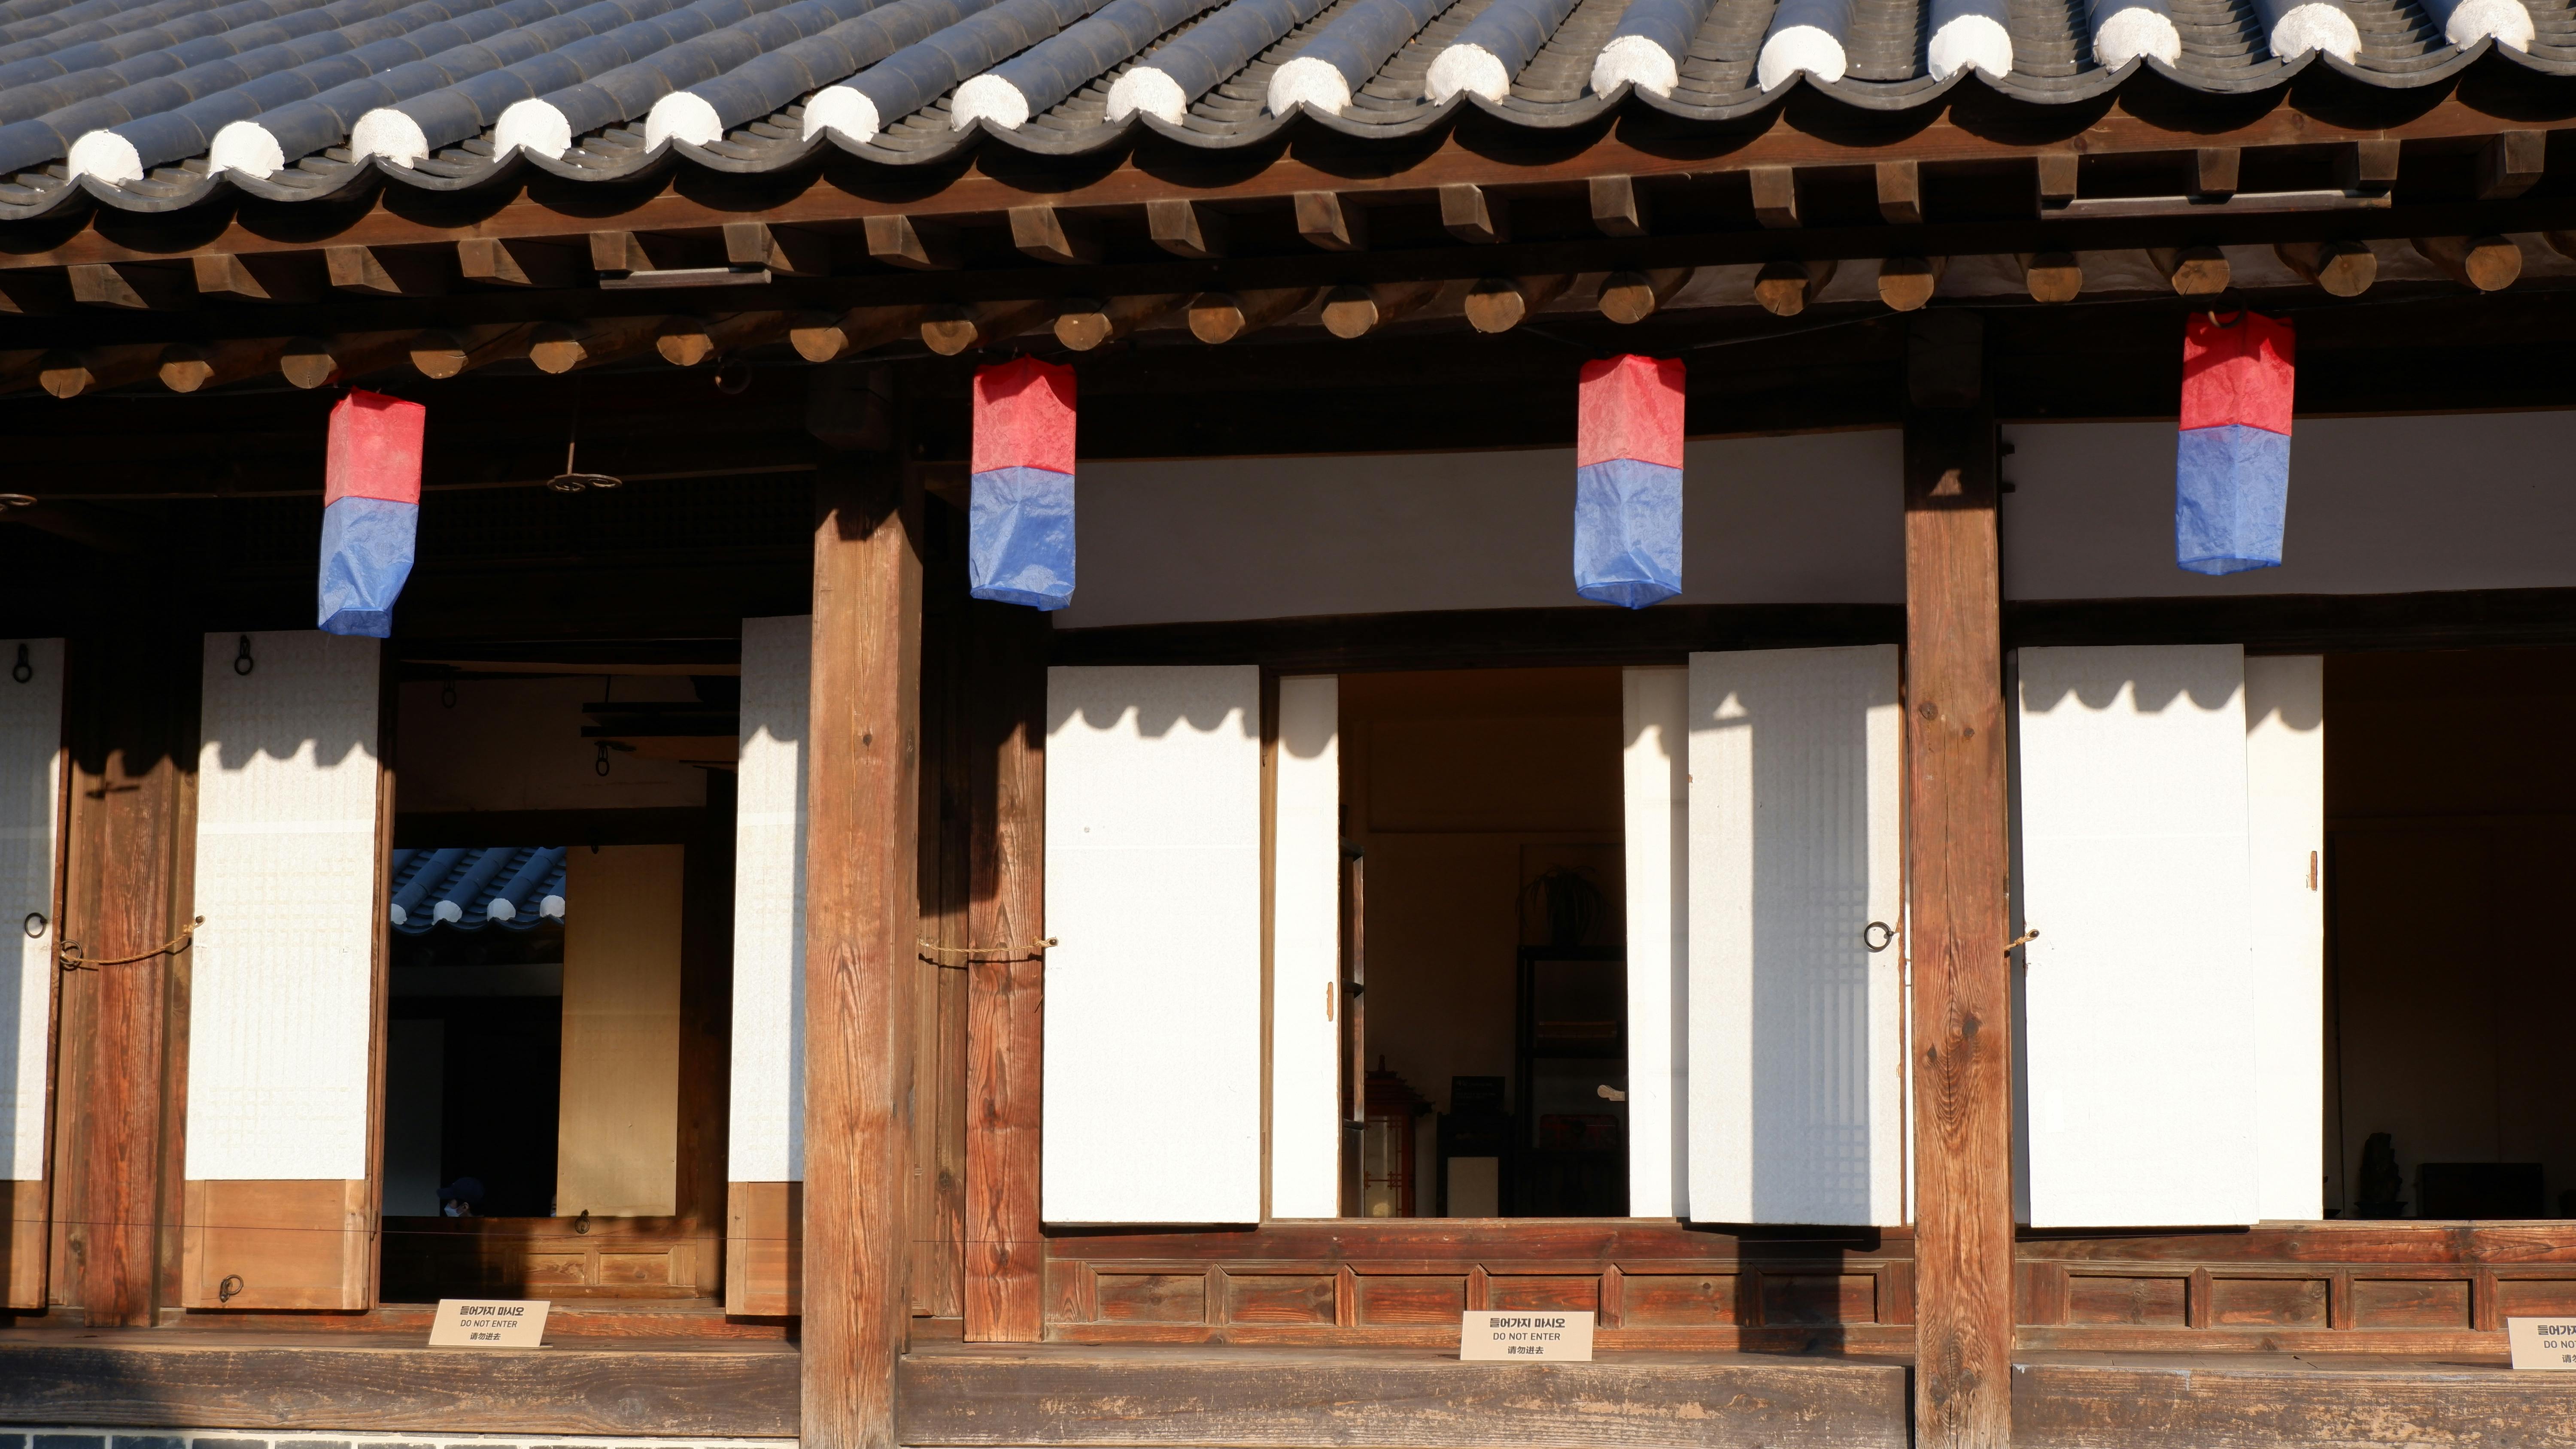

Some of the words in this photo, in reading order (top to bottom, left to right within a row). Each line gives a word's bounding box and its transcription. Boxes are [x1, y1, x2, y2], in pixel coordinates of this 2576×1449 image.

[460, 1306, 496, 1315] 들어가지
[498, 1307, 524, 1316] 마시오
[1490, 1318, 1531, 1328] 들어가지
[1534, 1318, 1565, 1328] 마시오
[1508, 1346, 1544, 1354] 请勿进去
